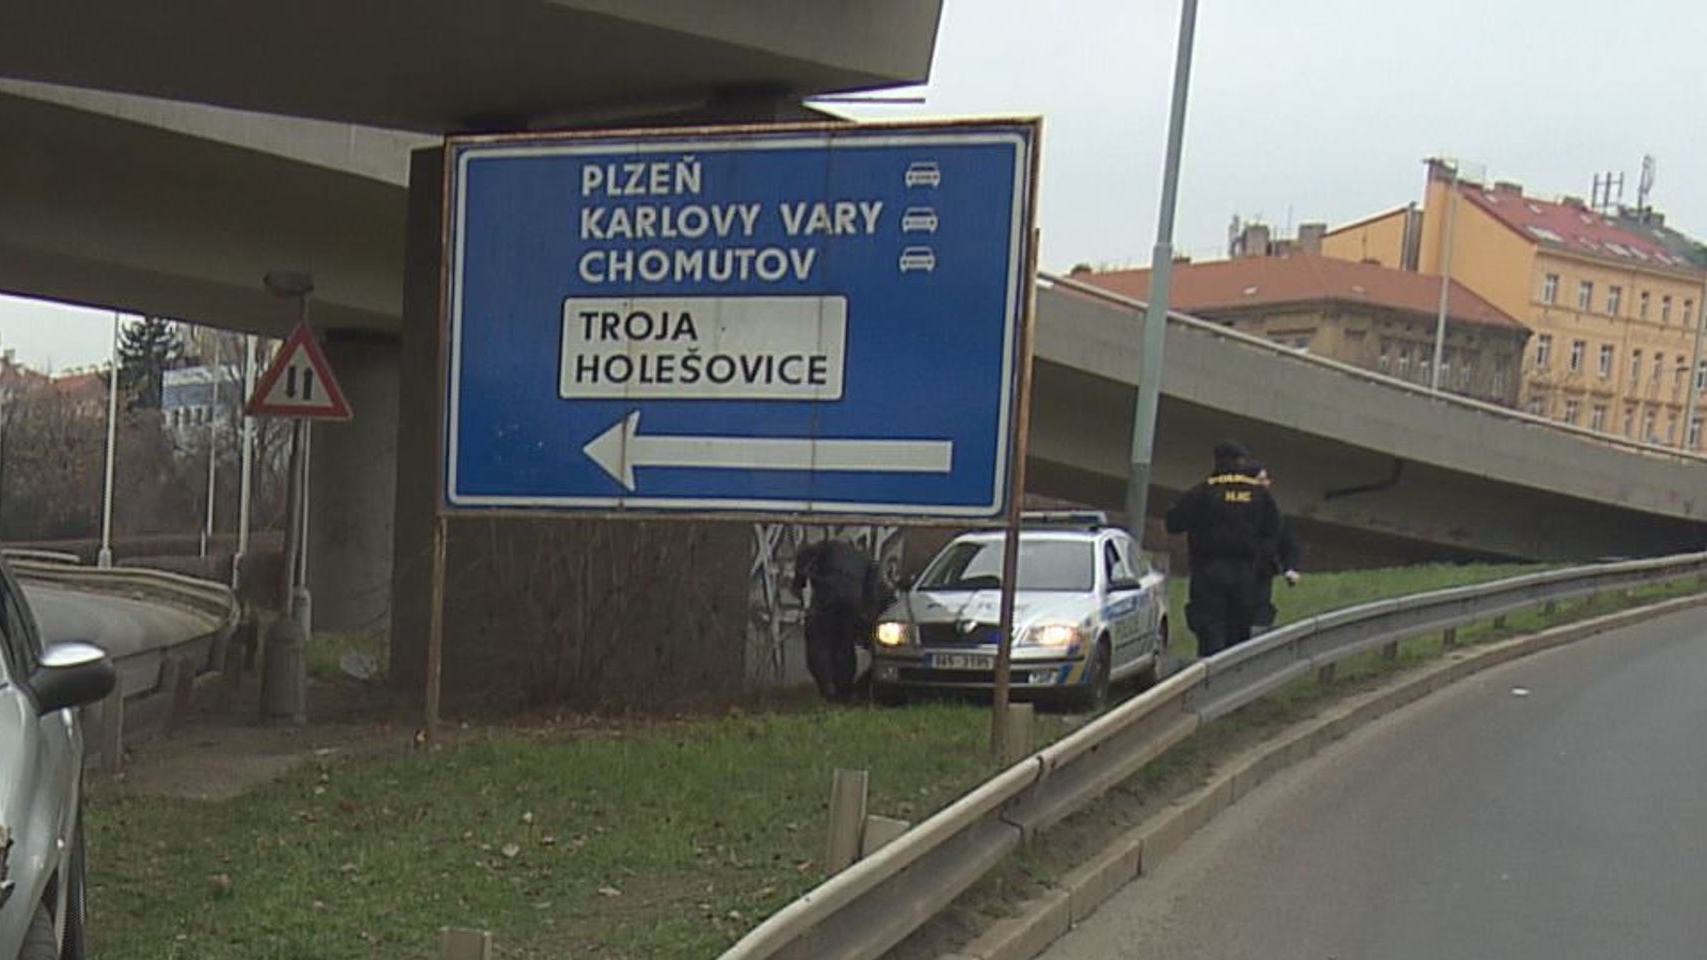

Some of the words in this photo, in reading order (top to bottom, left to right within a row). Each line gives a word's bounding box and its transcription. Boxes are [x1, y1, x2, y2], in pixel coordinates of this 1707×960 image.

[582, 155, 701, 197] PLZEŇ
[580, 203, 762, 240] KARLOVY
[779, 201, 884, 236] VARY
[578, 247, 816, 284] CHOMUTOV
[579, 310, 698, 342] TROJA
[575, 346, 828, 386] HOLEŠOVICE
